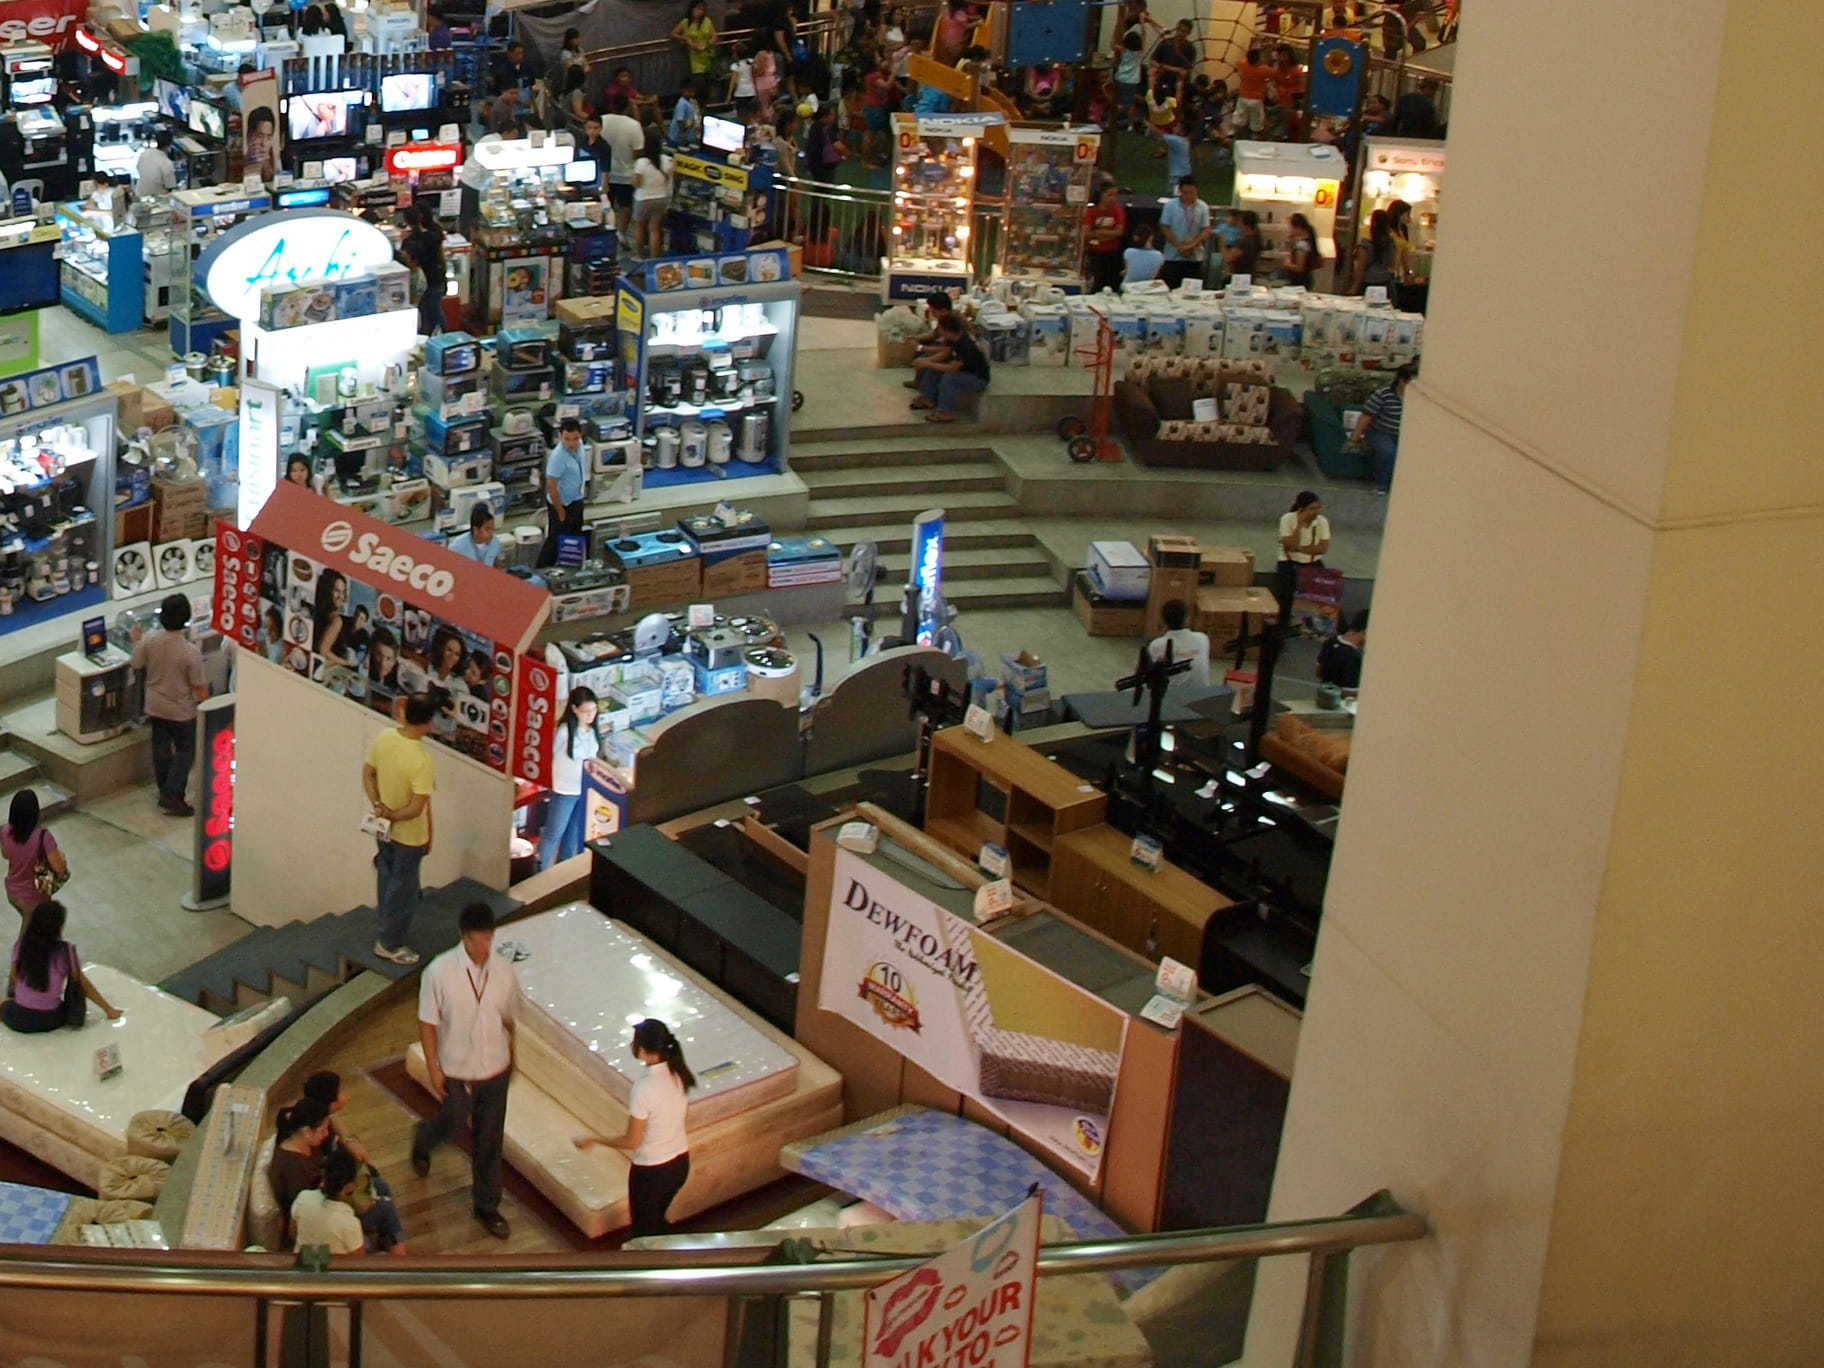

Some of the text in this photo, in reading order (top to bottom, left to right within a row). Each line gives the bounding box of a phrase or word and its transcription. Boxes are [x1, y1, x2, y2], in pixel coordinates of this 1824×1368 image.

[918, 114, 1000, 126] NOKIA
[221, 556, 240, 631] Saeco
[349, 532, 455, 598] Saeco
[522, 694, 549, 780] Saeco
[843, 878, 979, 982] DEWFOAM
[881, 965, 902, 993] 10
[943, 1281, 1022, 1353] YOUR
